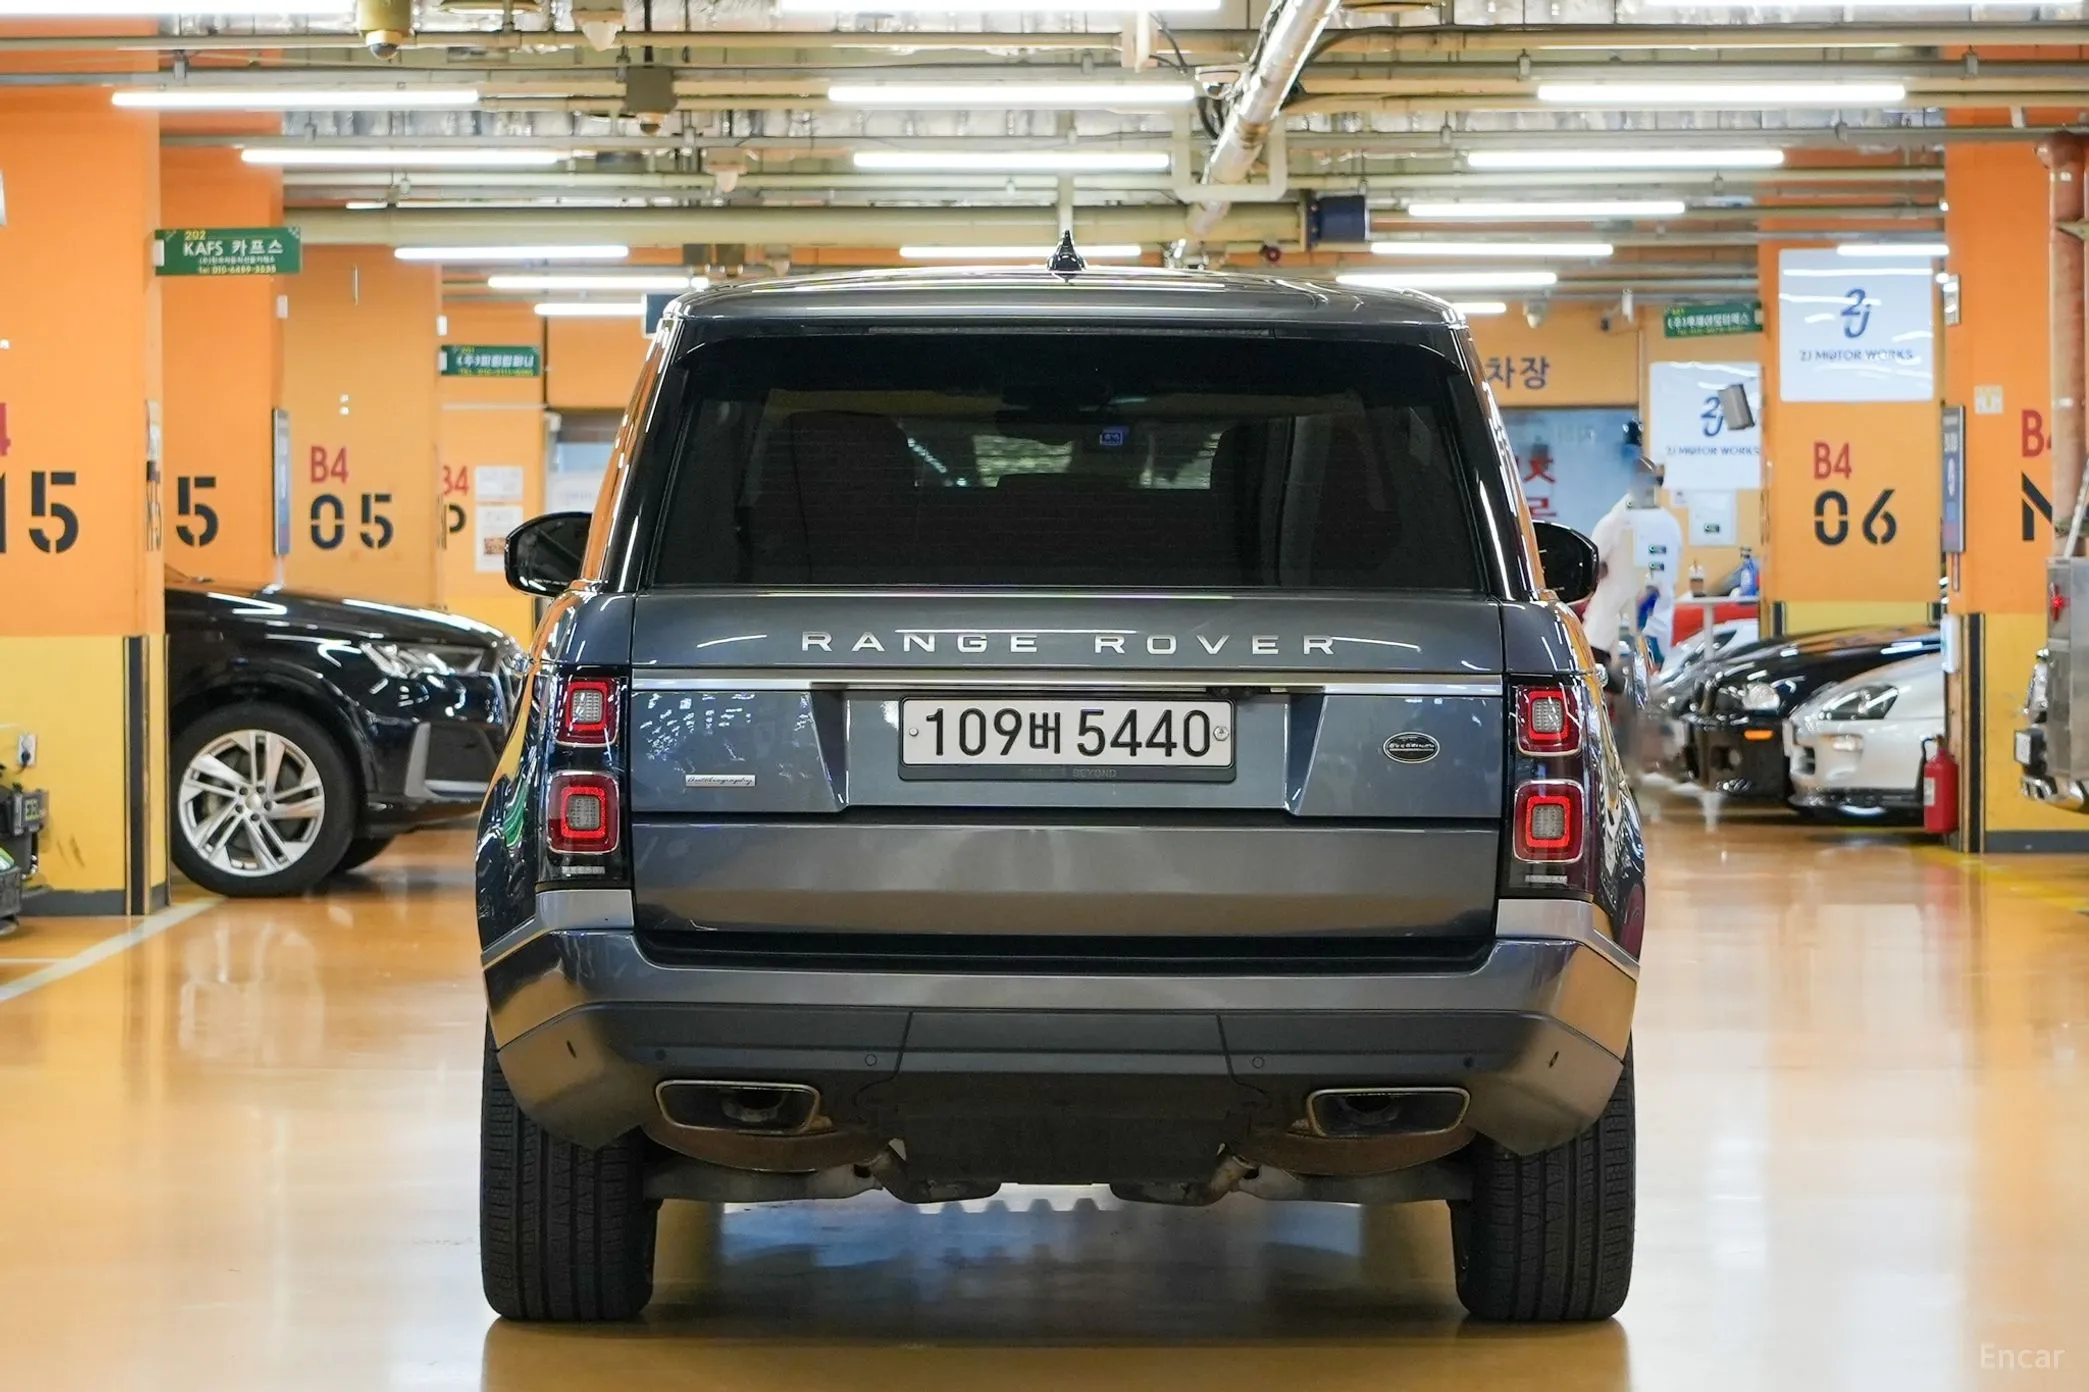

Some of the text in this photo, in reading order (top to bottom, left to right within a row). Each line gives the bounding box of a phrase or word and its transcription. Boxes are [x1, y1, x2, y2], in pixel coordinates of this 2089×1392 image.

[183, 239, 283, 256] KAFS 카프스
[185, 230, 206, 240] 202
[1865, 349, 1914, 361] WORKS
[2022, 410, 2052, 457] B
[310, 446, 349, 484] B4
[1814, 442, 1852, 480] B4
[310, 493, 394, 550] 05
[1814, 488, 1897, 546] 06
[801, 631, 1335, 656] RANGE ROVER
[925, 707, 1212, 758] 109버 5440
